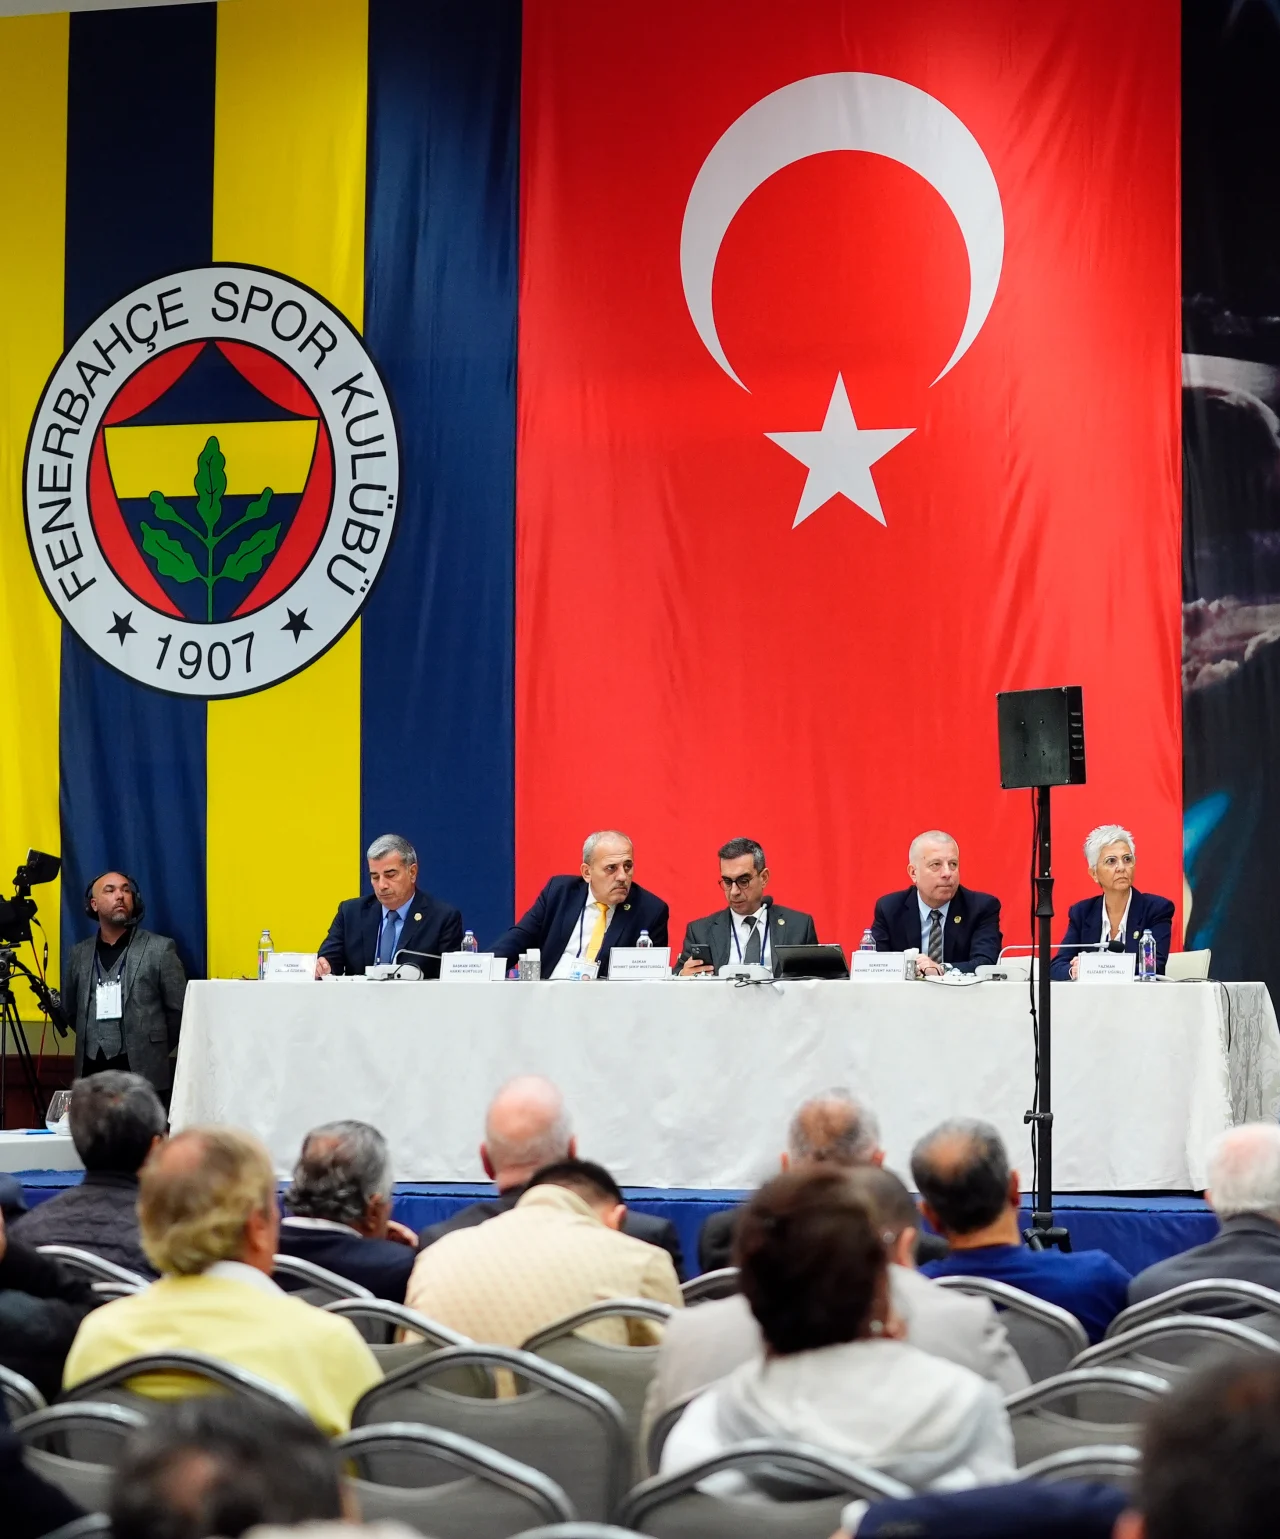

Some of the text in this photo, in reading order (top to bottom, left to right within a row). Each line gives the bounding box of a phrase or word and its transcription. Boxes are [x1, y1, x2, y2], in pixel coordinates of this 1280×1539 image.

[38, 281, 394, 602] FENERBAHÇE SPOR KULÜBÜ
[155, 631, 255, 682] 1907
